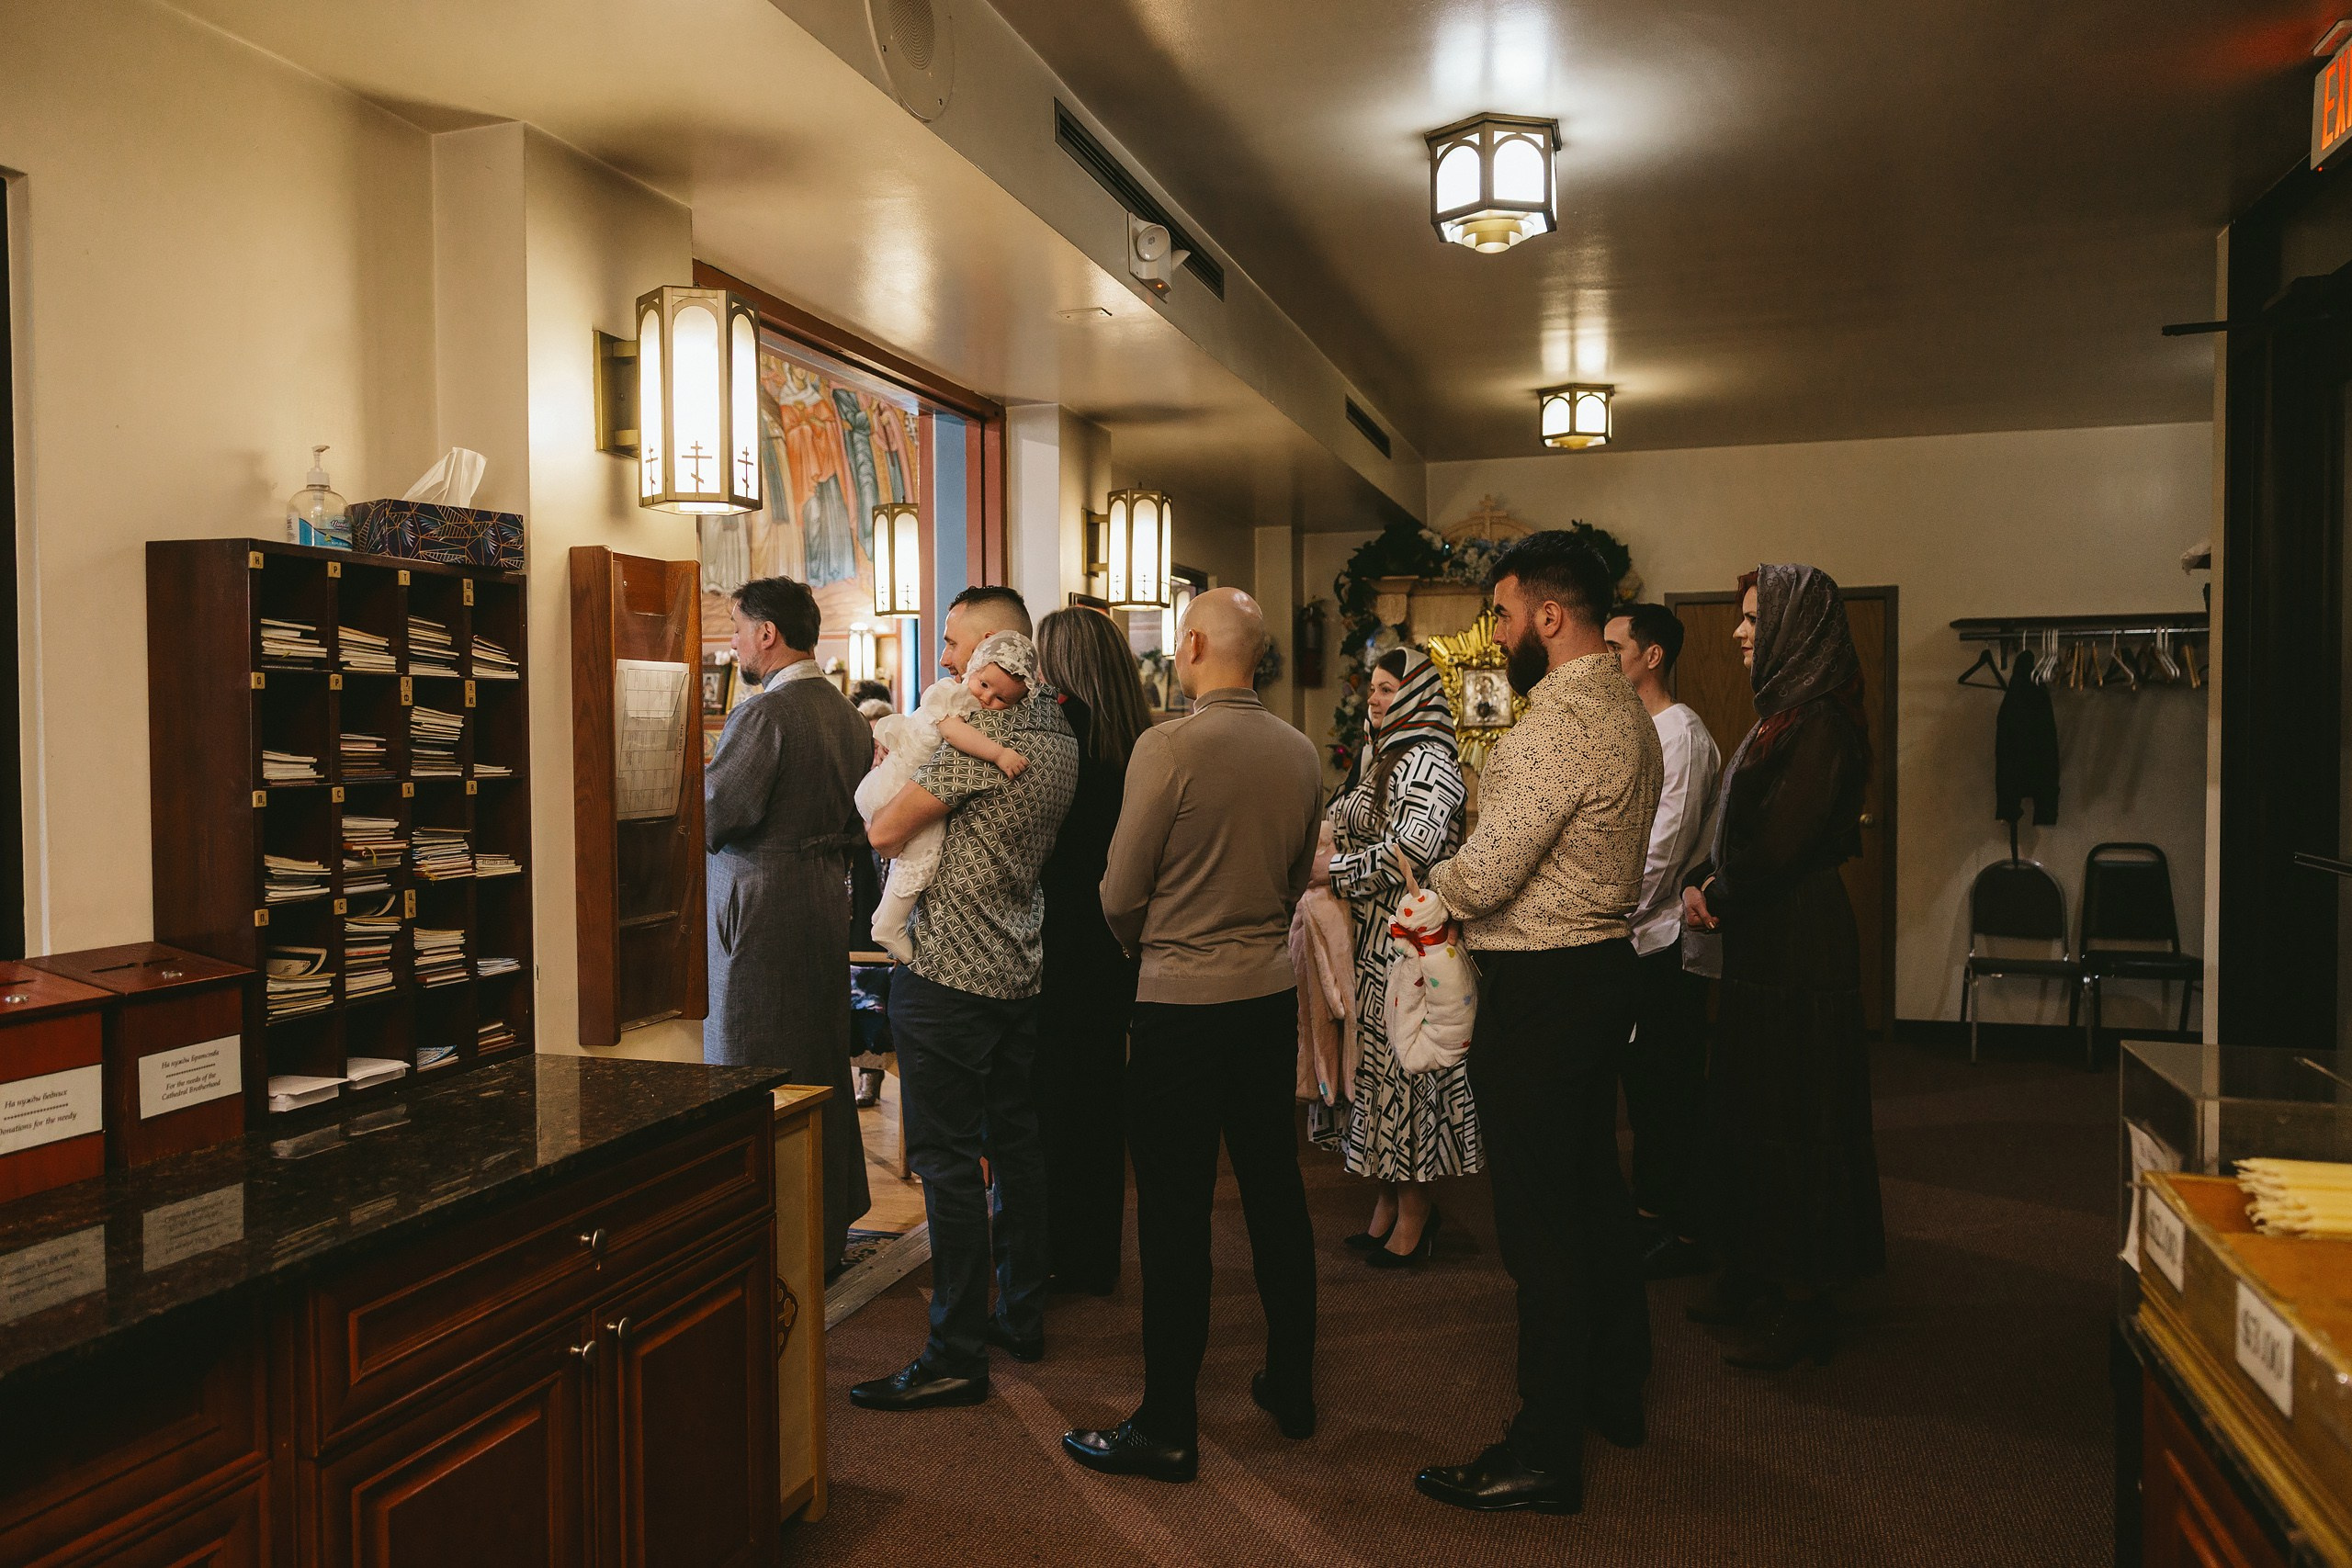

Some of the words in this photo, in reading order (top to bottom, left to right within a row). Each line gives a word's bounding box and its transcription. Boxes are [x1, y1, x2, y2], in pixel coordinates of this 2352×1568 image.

[161, 1088, 188, 1100] Cathedral
[188, 1079, 221, 1094] Brotherhood
[176, 1079, 186, 1089] the
[186, 1076, 201, 1087] needs
[201, 1074, 208, 1083] of
[208, 1072, 217, 1080] the
[33, 1120, 43, 1130] for
[45, 1116, 55, 1125] the
[57, 1111, 77, 1122] needy
